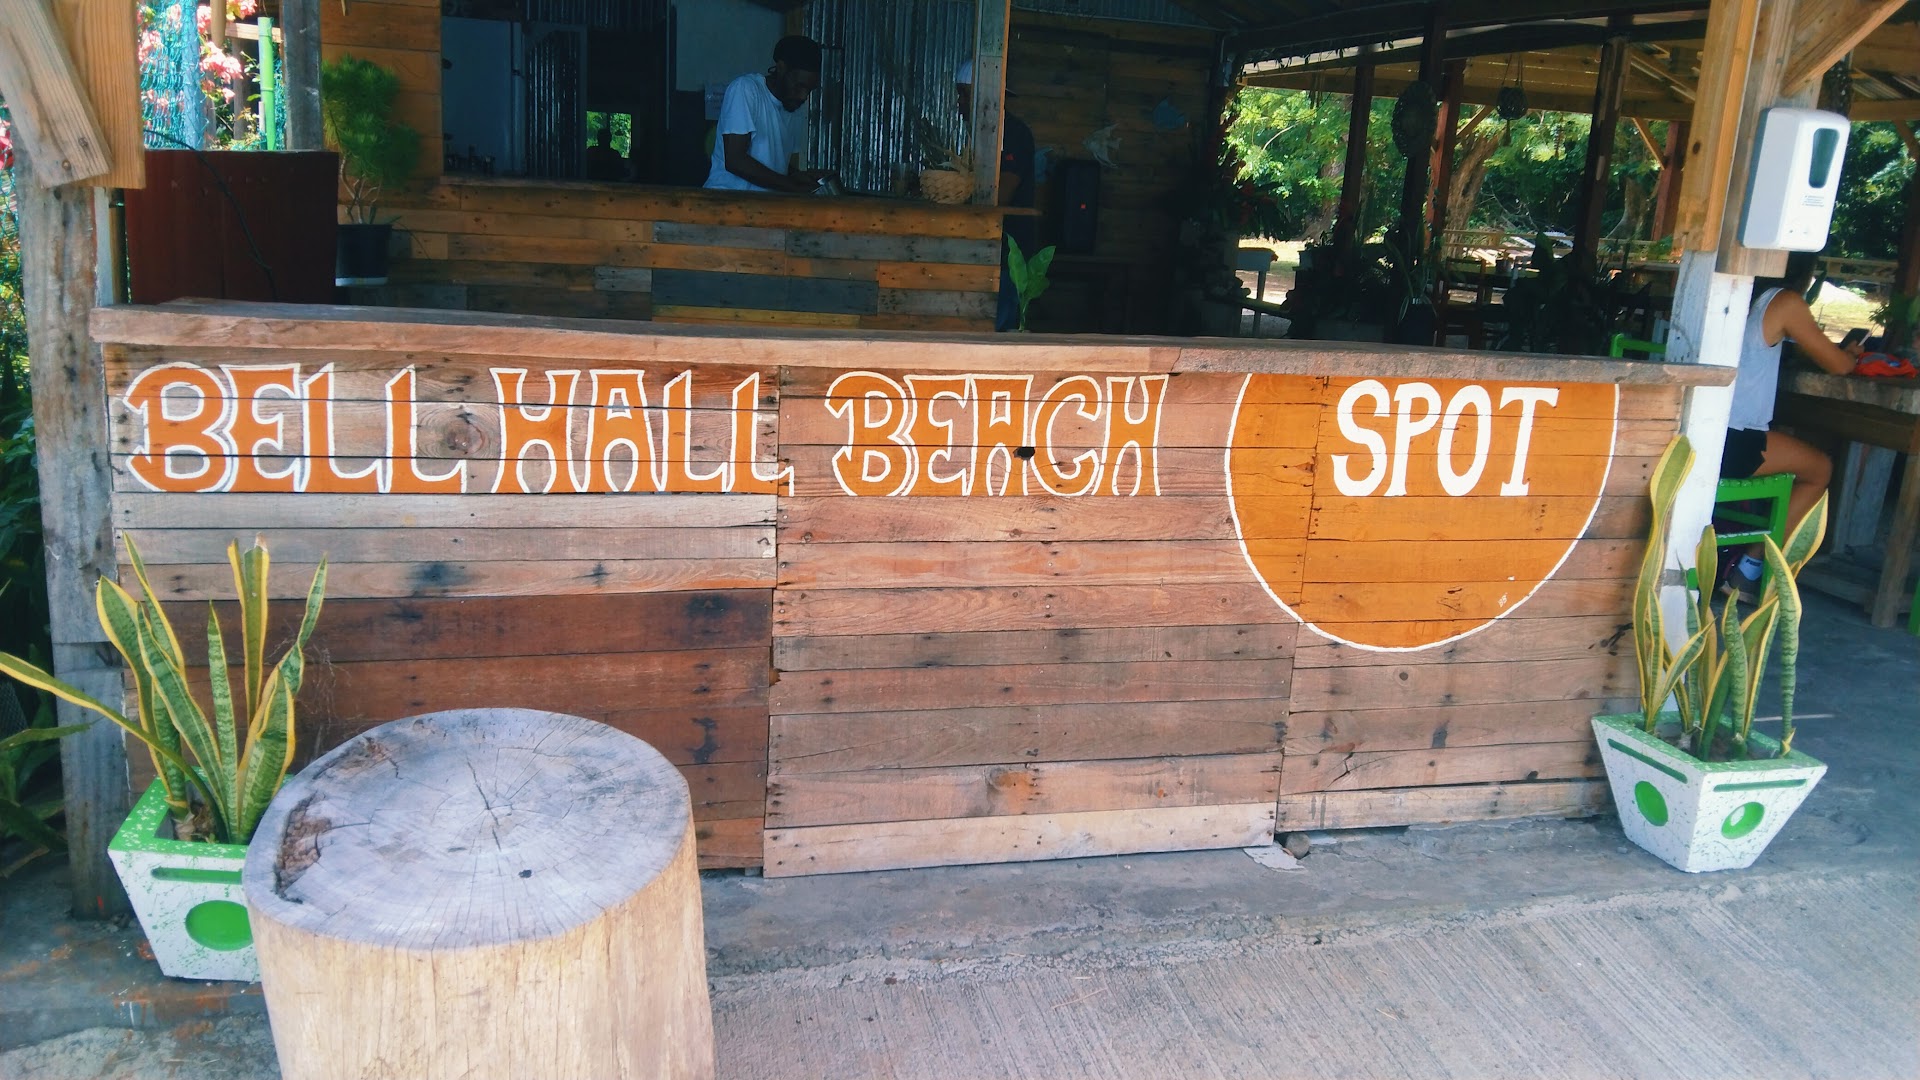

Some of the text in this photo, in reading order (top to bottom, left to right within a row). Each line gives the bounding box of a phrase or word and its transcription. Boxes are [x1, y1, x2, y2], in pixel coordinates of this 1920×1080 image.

[124, 362, 1560, 497] BELL HALL BEACH SPOT
